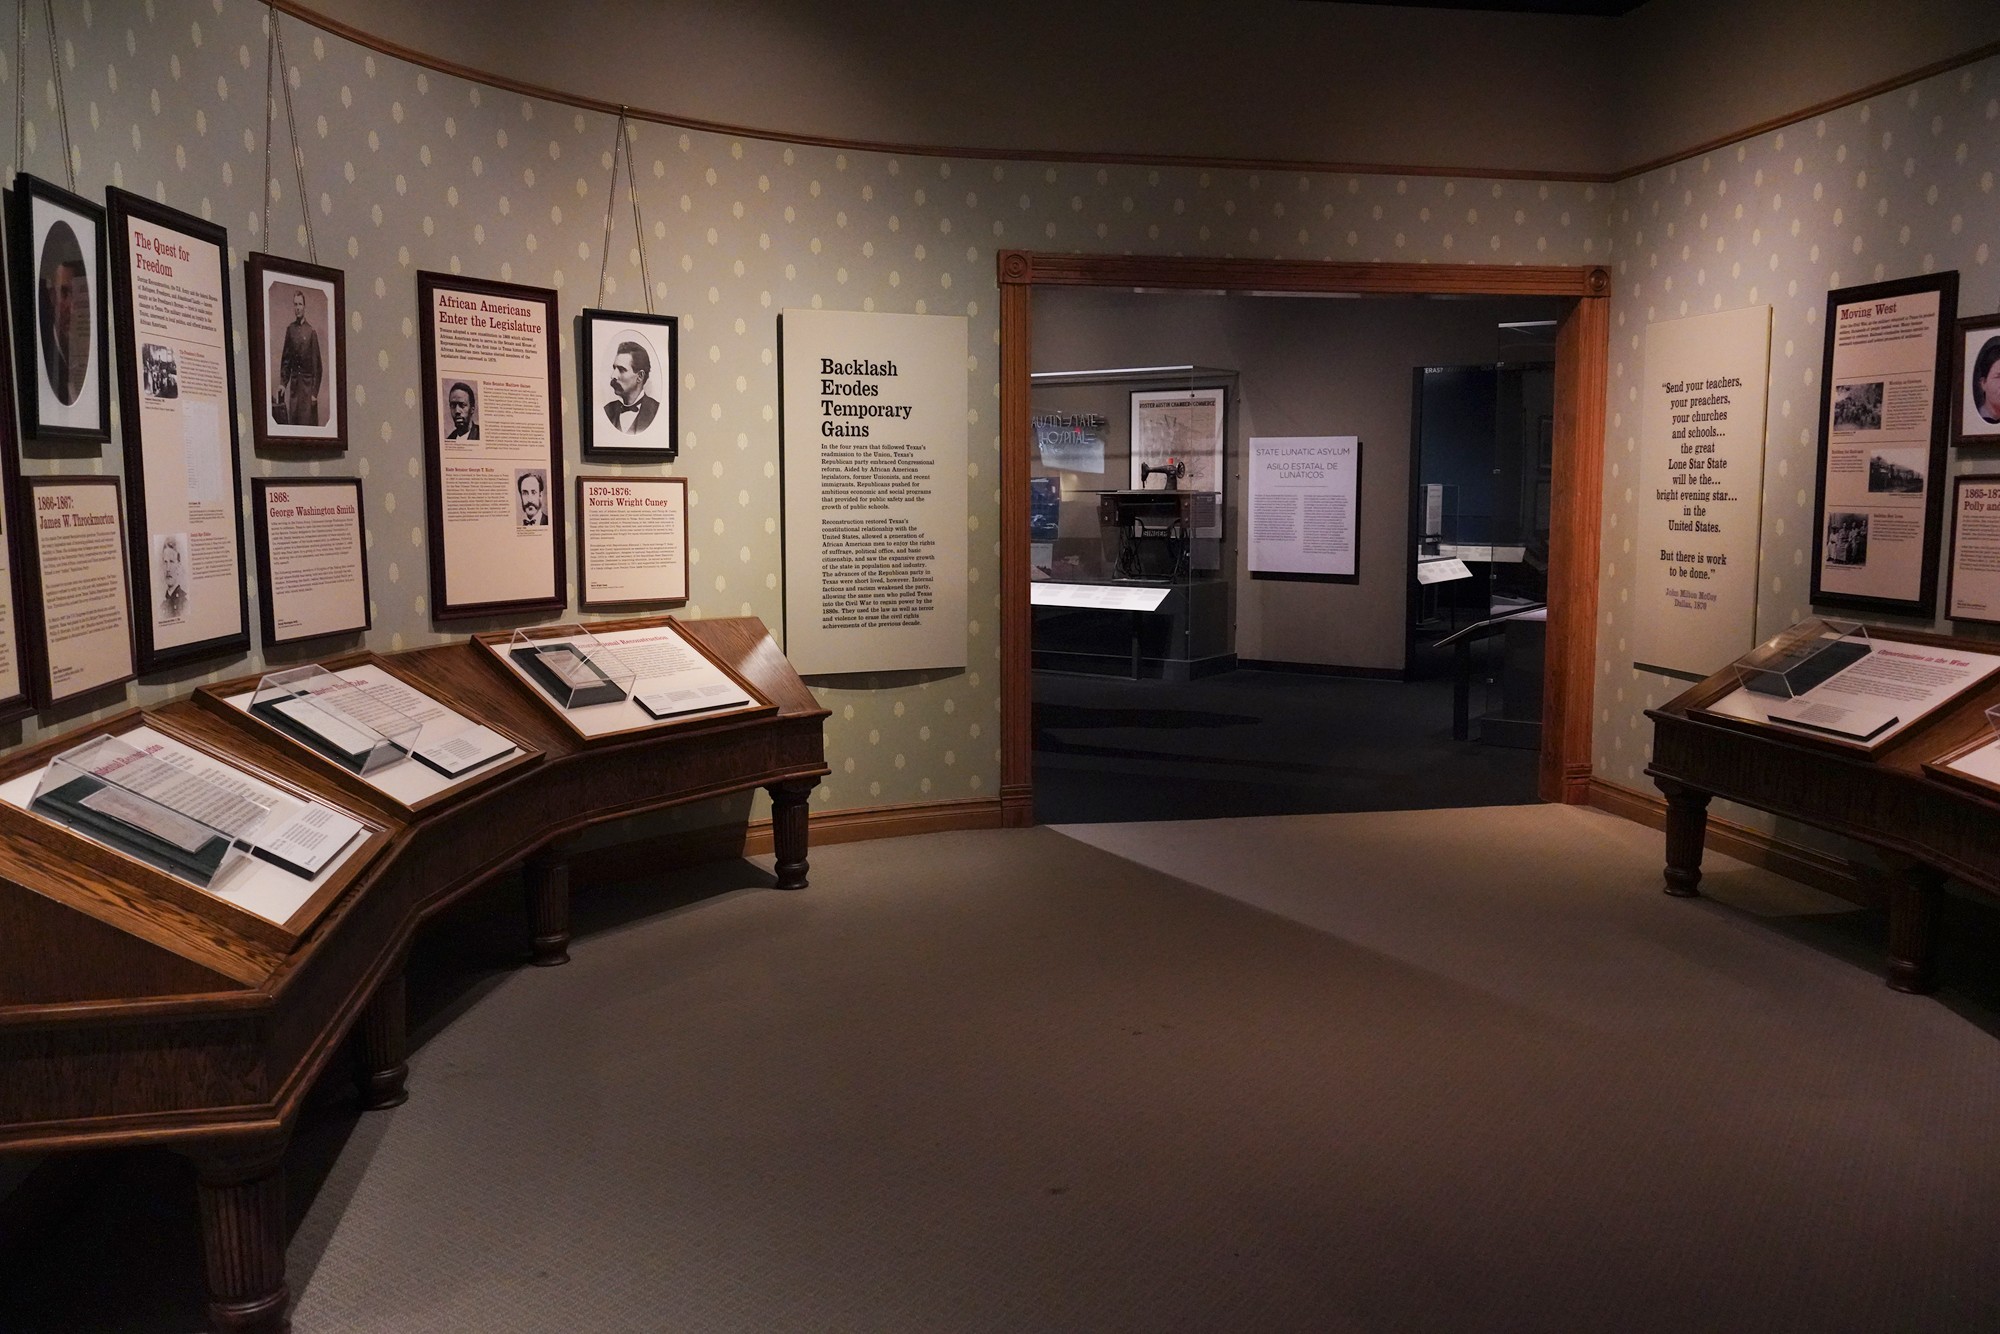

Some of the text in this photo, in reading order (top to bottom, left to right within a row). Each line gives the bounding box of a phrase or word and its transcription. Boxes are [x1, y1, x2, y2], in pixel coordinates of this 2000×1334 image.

[135, 232, 190, 262] The Quest for
[136, 253, 172, 277] Freedom
[439, 295, 531, 317] African Americans
[1841, 302, 1896, 320] Moving West
[439, 311, 541, 333] Enter the Legislature
[821, 358, 898, 376] Backlash
[821, 380, 878, 396] Erodes
[1686, 381, 1703, 393] your
[1706, 377, 1742, 389] teachers,
[1671, 395, 1730, 409] your preachers,
[822, 400, 912, 420] Temporary
[1672, 410, 1727, 424] your churches
[1031, 414, 1097, 428] AUSTIN STATE
[822, 421, 869, 437] Gains
[1672, 429, 1686, 439] and
[1042, 431, 1088, 444] HOSPITAL
[1681, 443, 1714, 455] the great
[1669, 458, 1727, 470] Lone Star State
[1673, 474, 1686, 484] will
[1689, 474, 1697, 484] be
[270, 492, 289, 502] 1868:
[589, 488, 631, 496] 1870-1876:
[1657, 490, 1678, 502] bright
[1680, 490, 1709, 502] evening
[38, 496, 73, 510] 1866-1867:
[590, 498, 667, 507] Norris Wright Cuney
[1964, 501, 1984, 512] Polly
[270, 505, 355, 518] George Washington Smith
[1684, 505, 1706, 516] in the
[40, 513, 114, 529] James W. Throckmorton
[1669, 520, 1720, 532] United States.
[1660, 550, 1727, 565] But there is work
[1670, 567, 1676, 576] to
[1679, 566, 1687, 577] be
[1666, 588, 1678, 596] John
[1680, 590, 1697, 599] Milton
